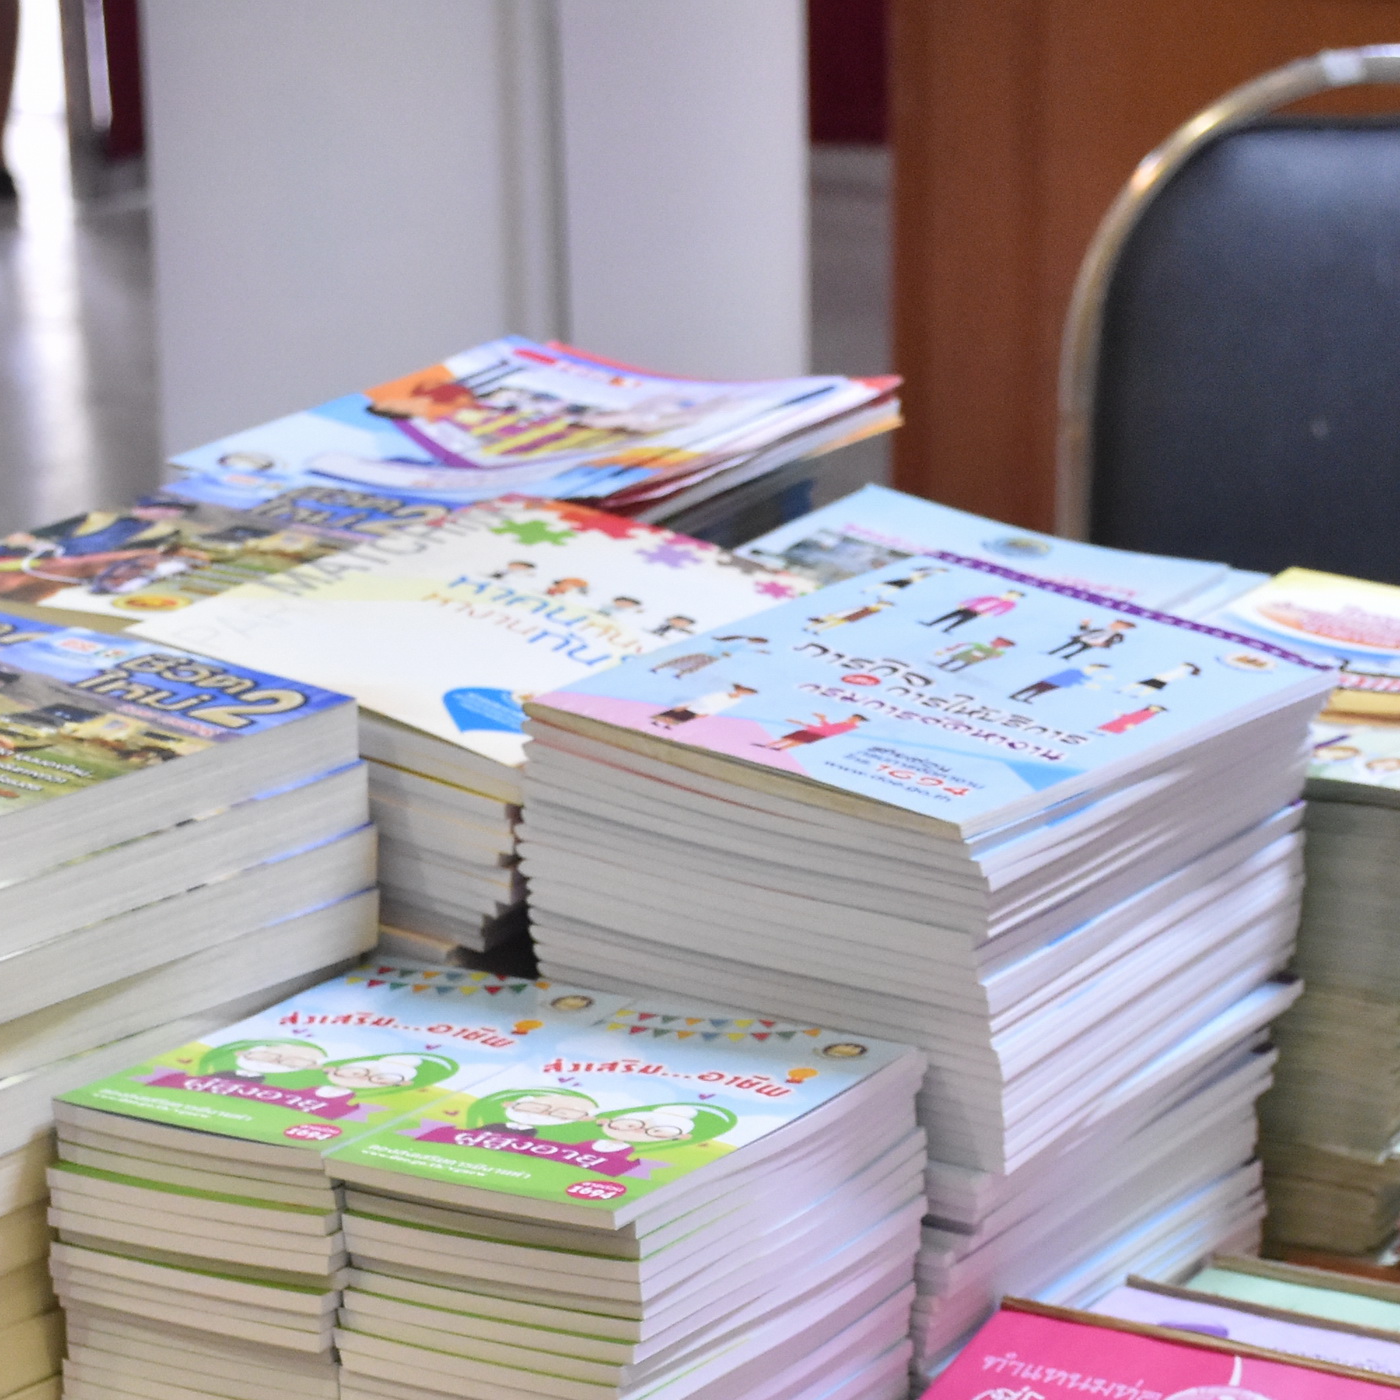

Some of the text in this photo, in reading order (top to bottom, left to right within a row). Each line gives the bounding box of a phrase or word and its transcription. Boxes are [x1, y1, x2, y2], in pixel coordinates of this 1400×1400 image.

[192, 678, 307, 730] 2
[798, 683, 1063, 761] กรมการจัดหางาน
[886, 684, 1089, 746] การให้บริการ
[876, 763, 973, 797] 1694
[183, 1077, 330, 1115] ผู้สูงอายุ
[282, 1125, 339, 1142] 1694
[454, 1128, 607, 1172] ผู้สูงอายุ
[566, 1184, 618, 1200] 1694
